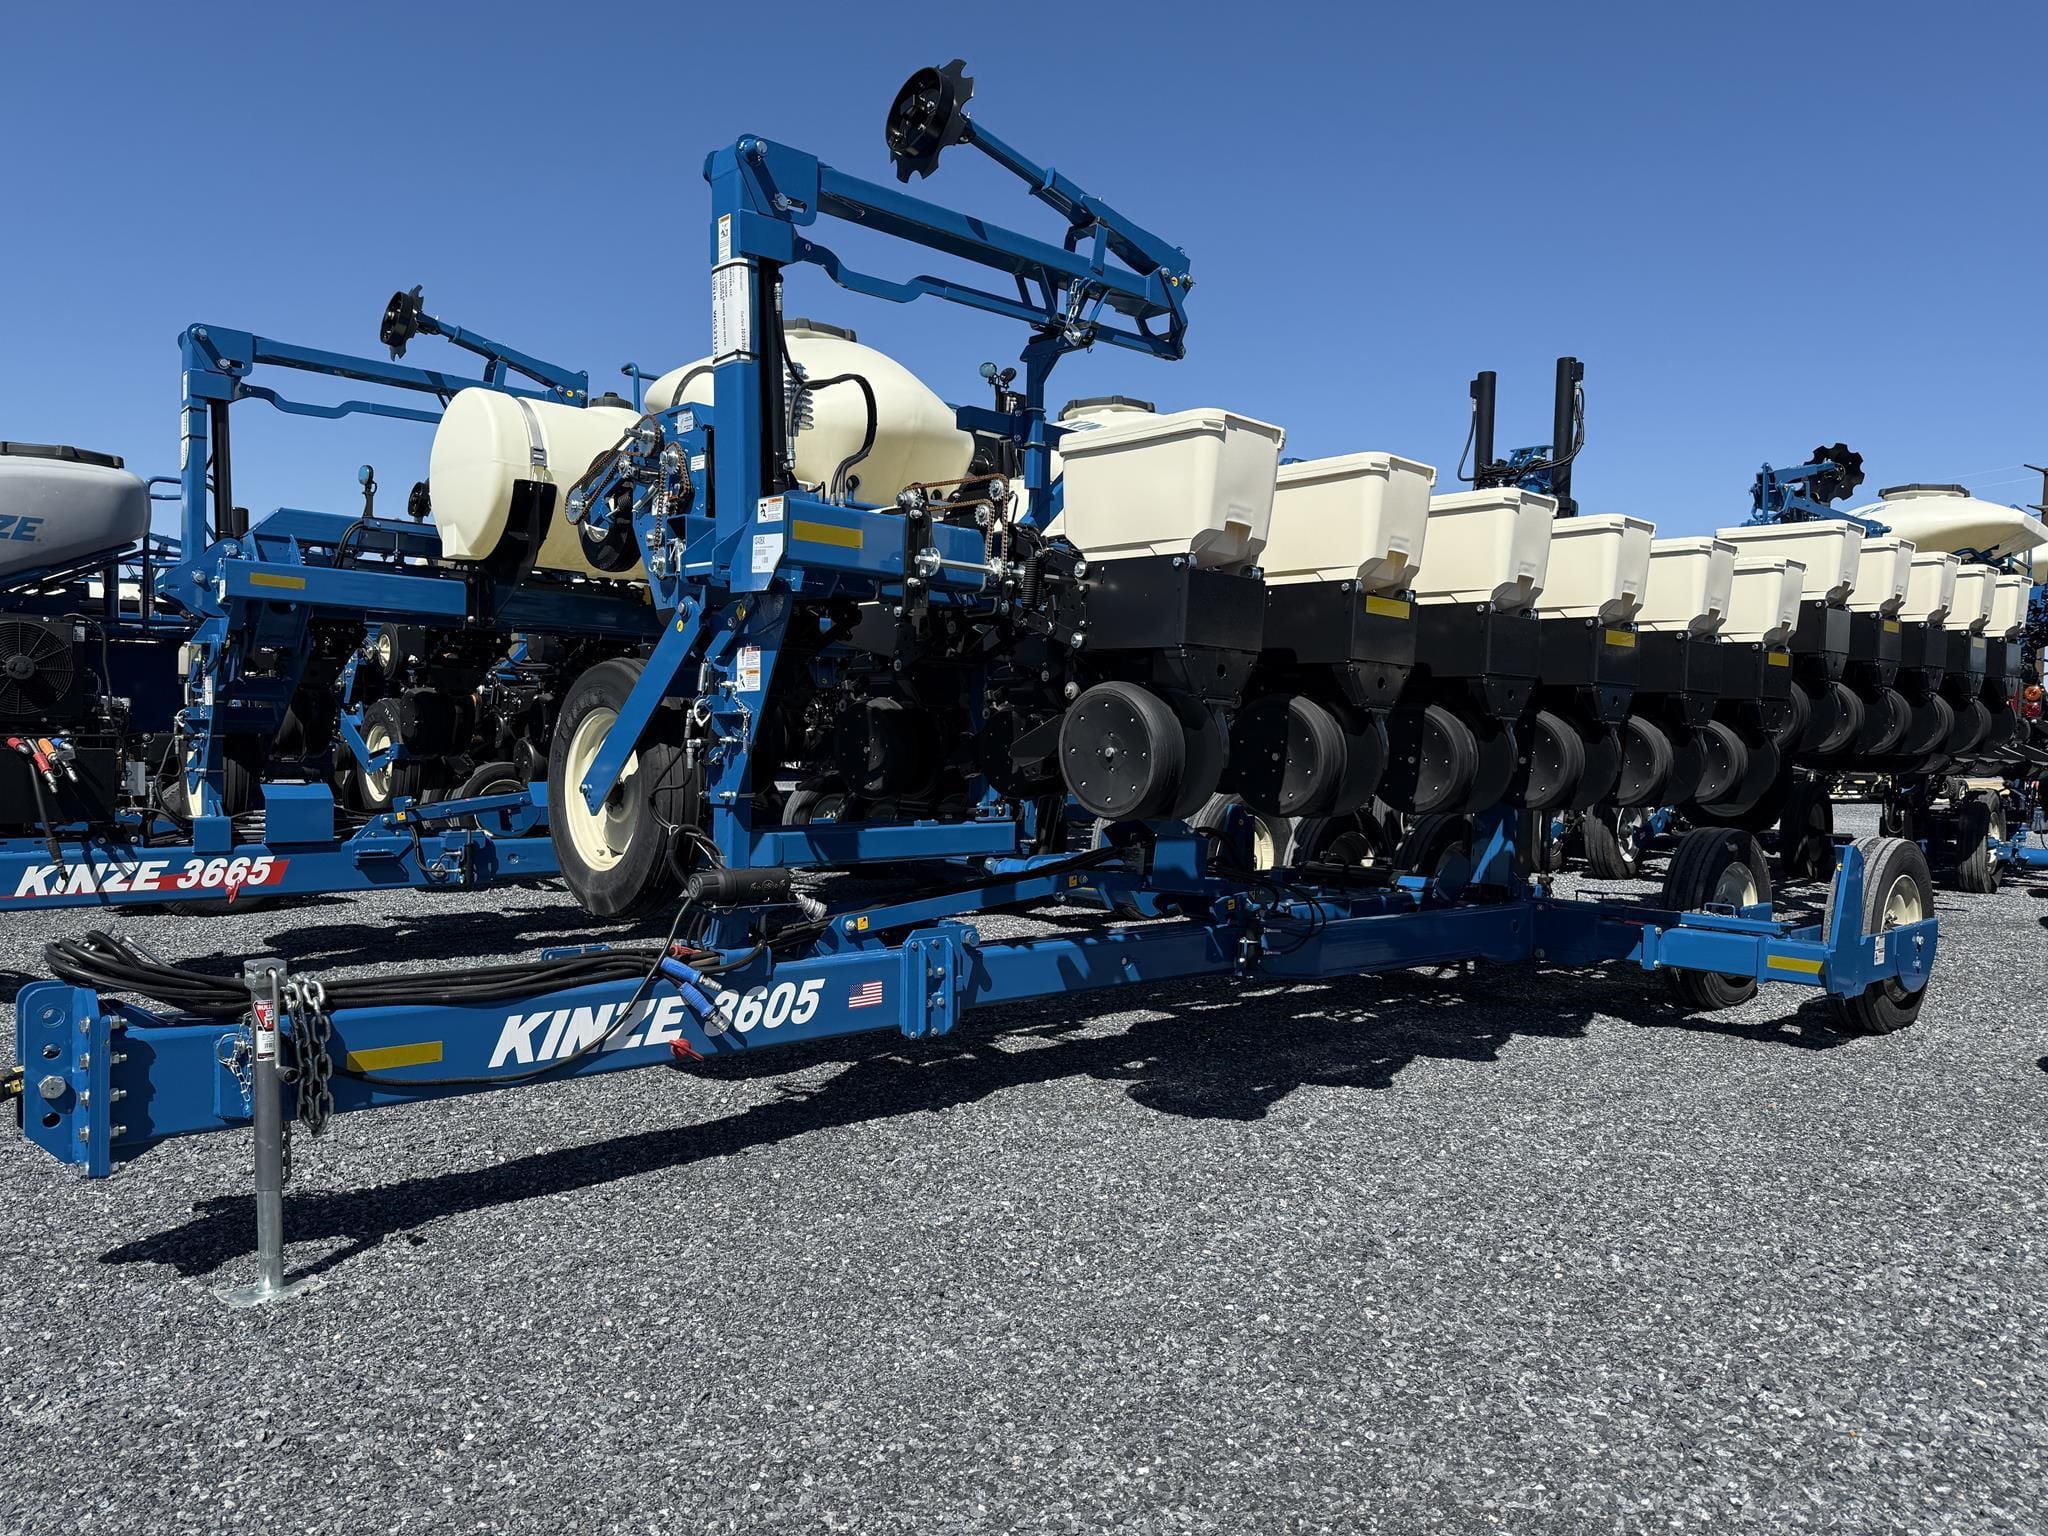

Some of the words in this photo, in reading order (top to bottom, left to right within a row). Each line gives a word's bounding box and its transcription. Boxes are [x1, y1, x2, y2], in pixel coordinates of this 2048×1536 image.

[14, 860, 169, 897] KINZE
[176, 856, 275, 889] 3665
[488, 995, 688, 1069] KINZE
[704, 978, 826, 1037] 3605
